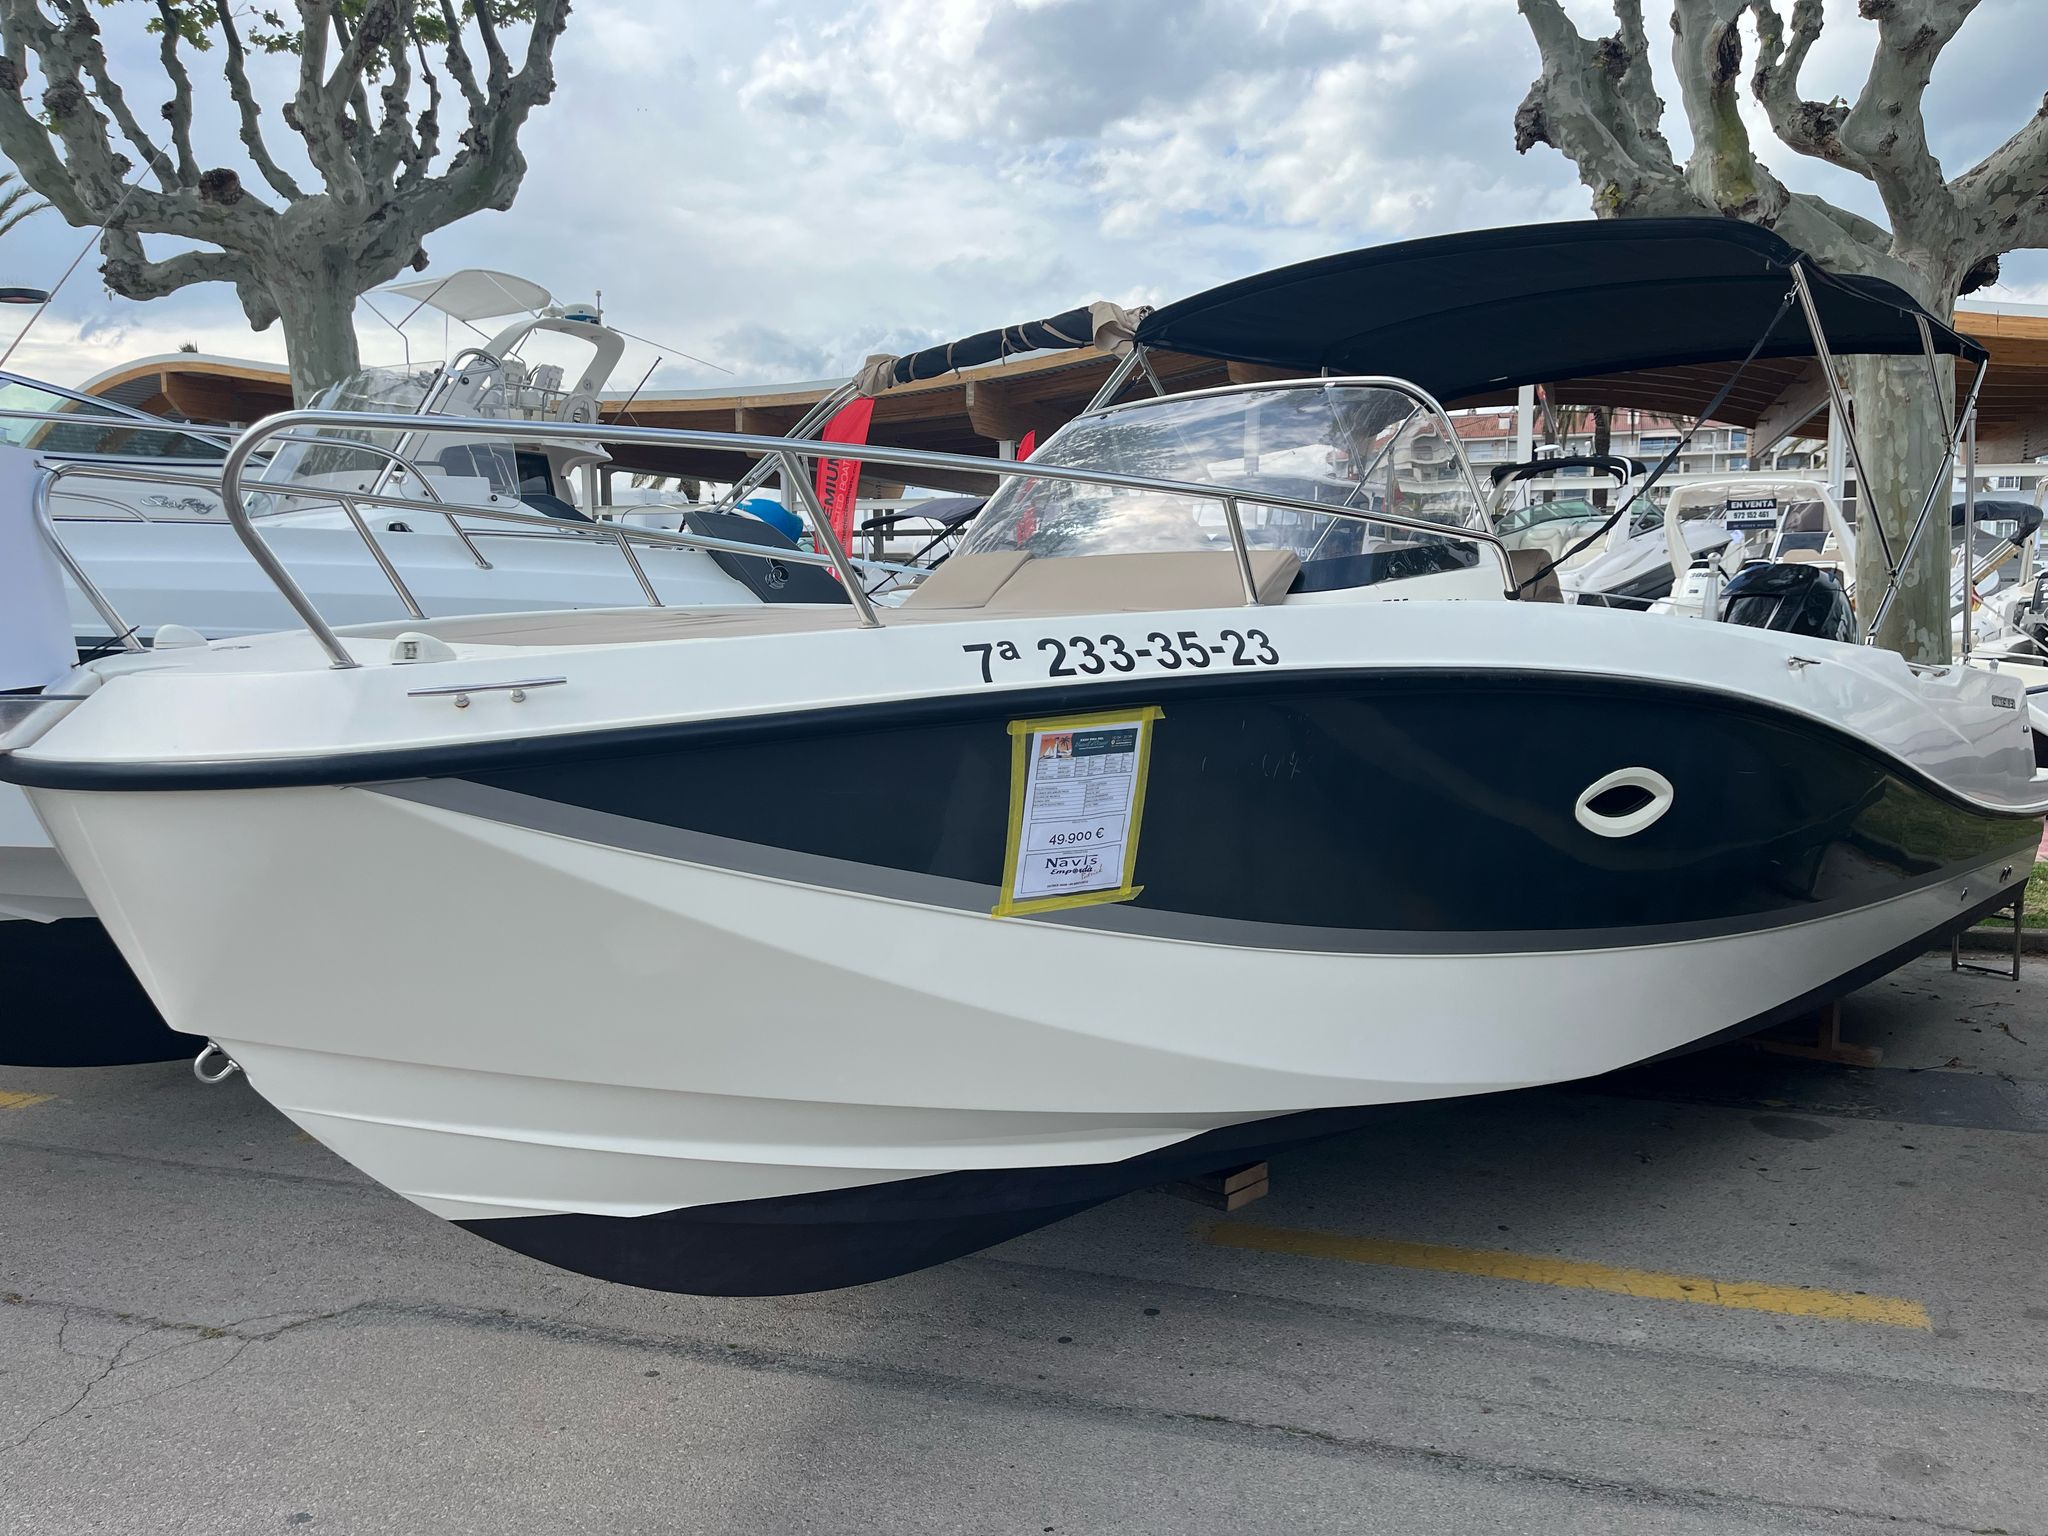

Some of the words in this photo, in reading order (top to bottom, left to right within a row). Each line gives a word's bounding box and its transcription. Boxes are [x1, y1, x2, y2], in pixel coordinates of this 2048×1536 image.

[839, 459, 850, 491] BOAT
[1731, 501, 1743, 509] EN
[1744, 500, 1774, 509] VENTA
[1037, 629, 1279, 678] 233-35-23
[1049, 830, 1092, 845] 49.900
[1096, 827, 1105, 839] €
